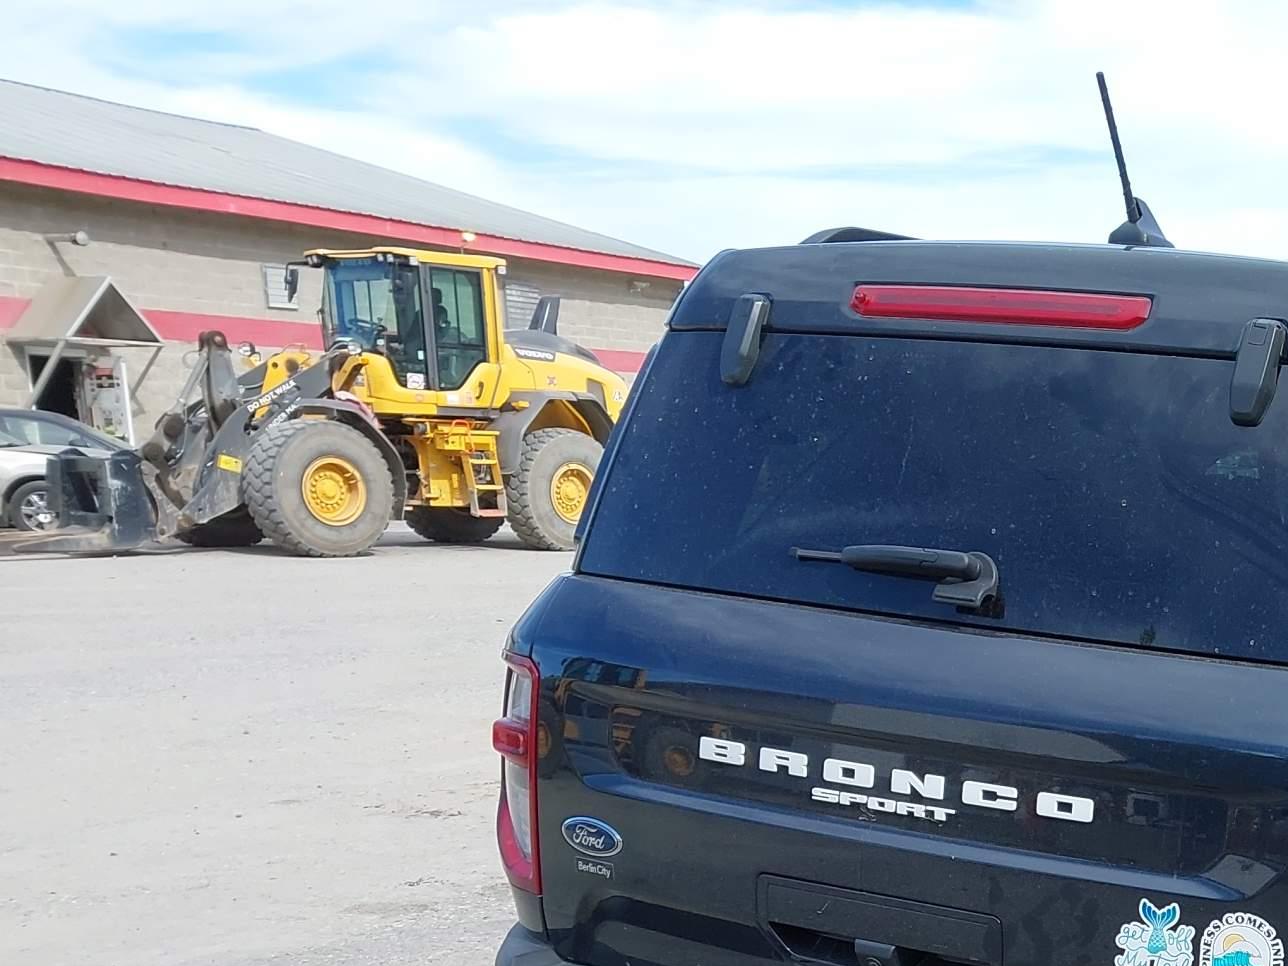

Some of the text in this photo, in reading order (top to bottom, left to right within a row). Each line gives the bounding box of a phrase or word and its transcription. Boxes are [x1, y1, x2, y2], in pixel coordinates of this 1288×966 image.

[515, 348, 554, 360] VOLVO
[247, 380, 296, 412] DO NOT WALK
[699, 736, 1095, 823] BRONCO
[811, 787, 957, 822] SPORT
[572, 824, 606, 850] Ford
[577, 860, 612, 879] Berlin City
[1118, 924, 1193, 952] get off
[1225, 915, 1274, 938] COMES
[1271, 941, 1282, 957] IN
